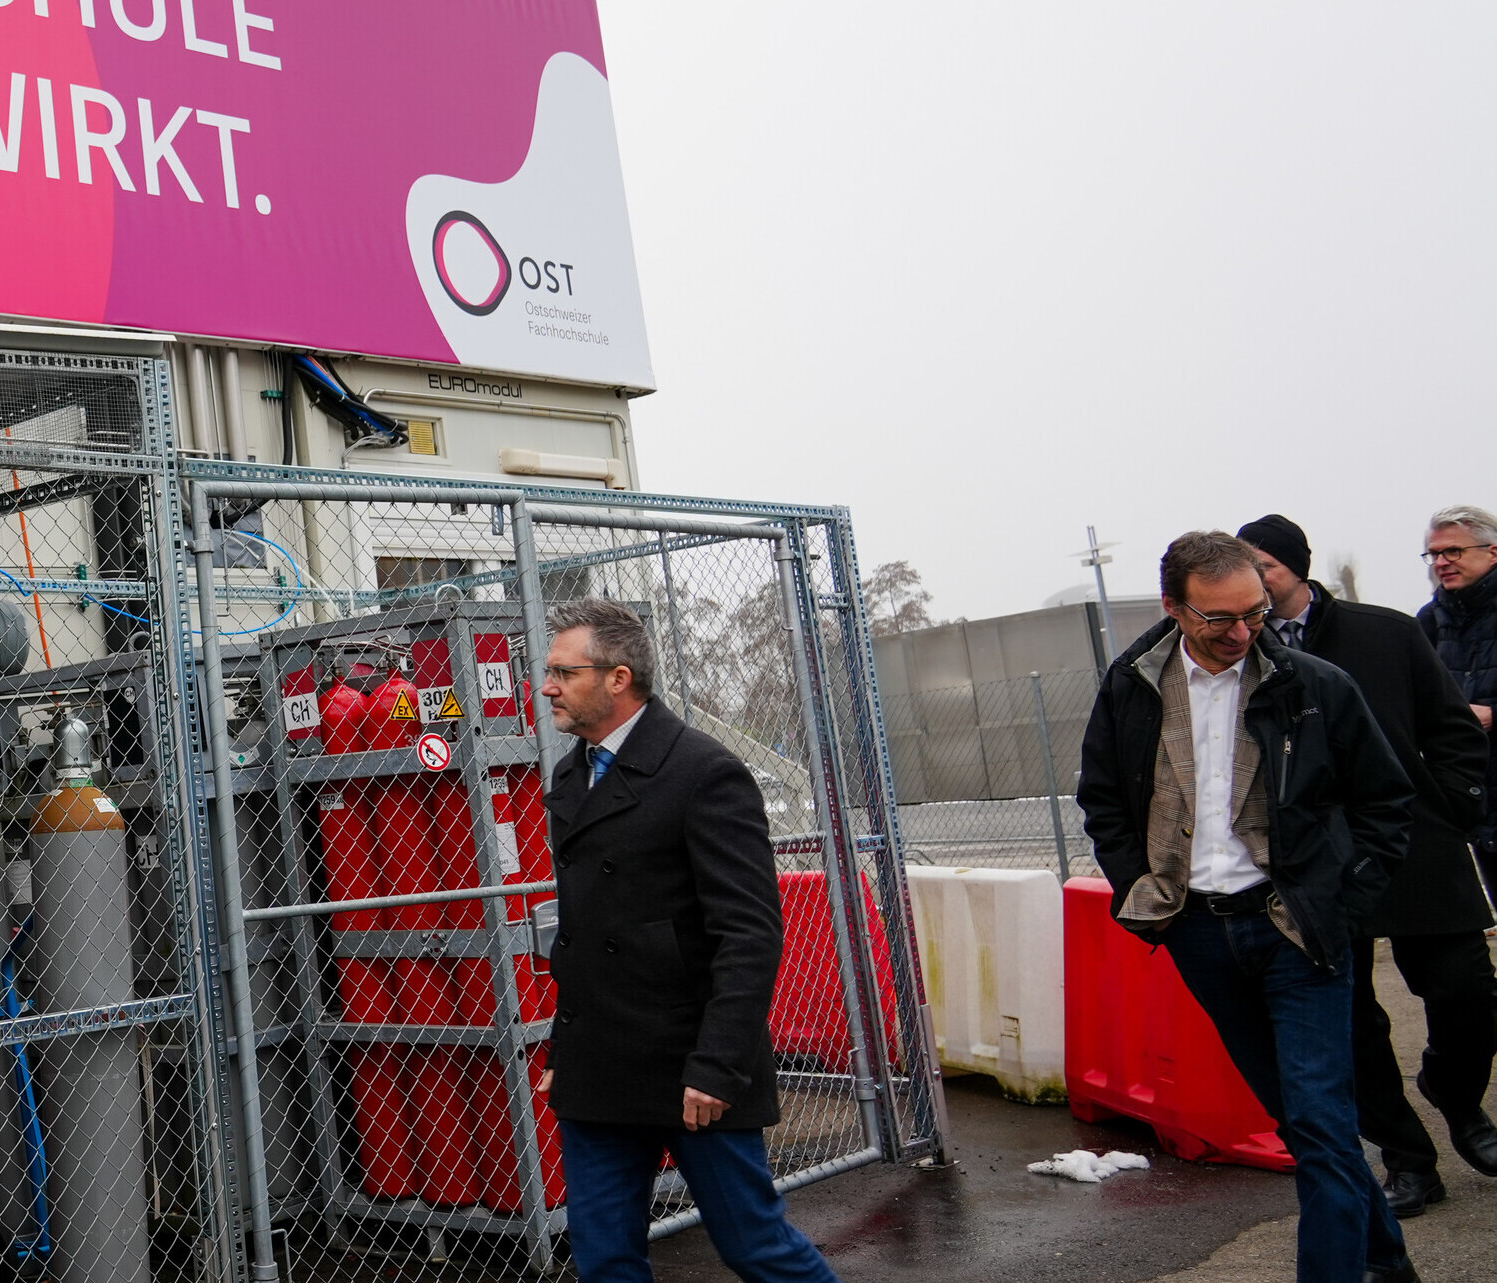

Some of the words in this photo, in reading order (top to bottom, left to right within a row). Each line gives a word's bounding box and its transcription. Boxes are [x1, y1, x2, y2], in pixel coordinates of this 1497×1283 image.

[519, 256, 574, 296] OST
[525, 301, 592, 324] Ostschweizer
[528, 321, 610, 346] Fachhochschule
[428, 374, 523, 399] EUROmodul
[485, 669, 504, 691] CH
[291, 699, 310, 722] CH
[398, 706, 409, 716] EX
